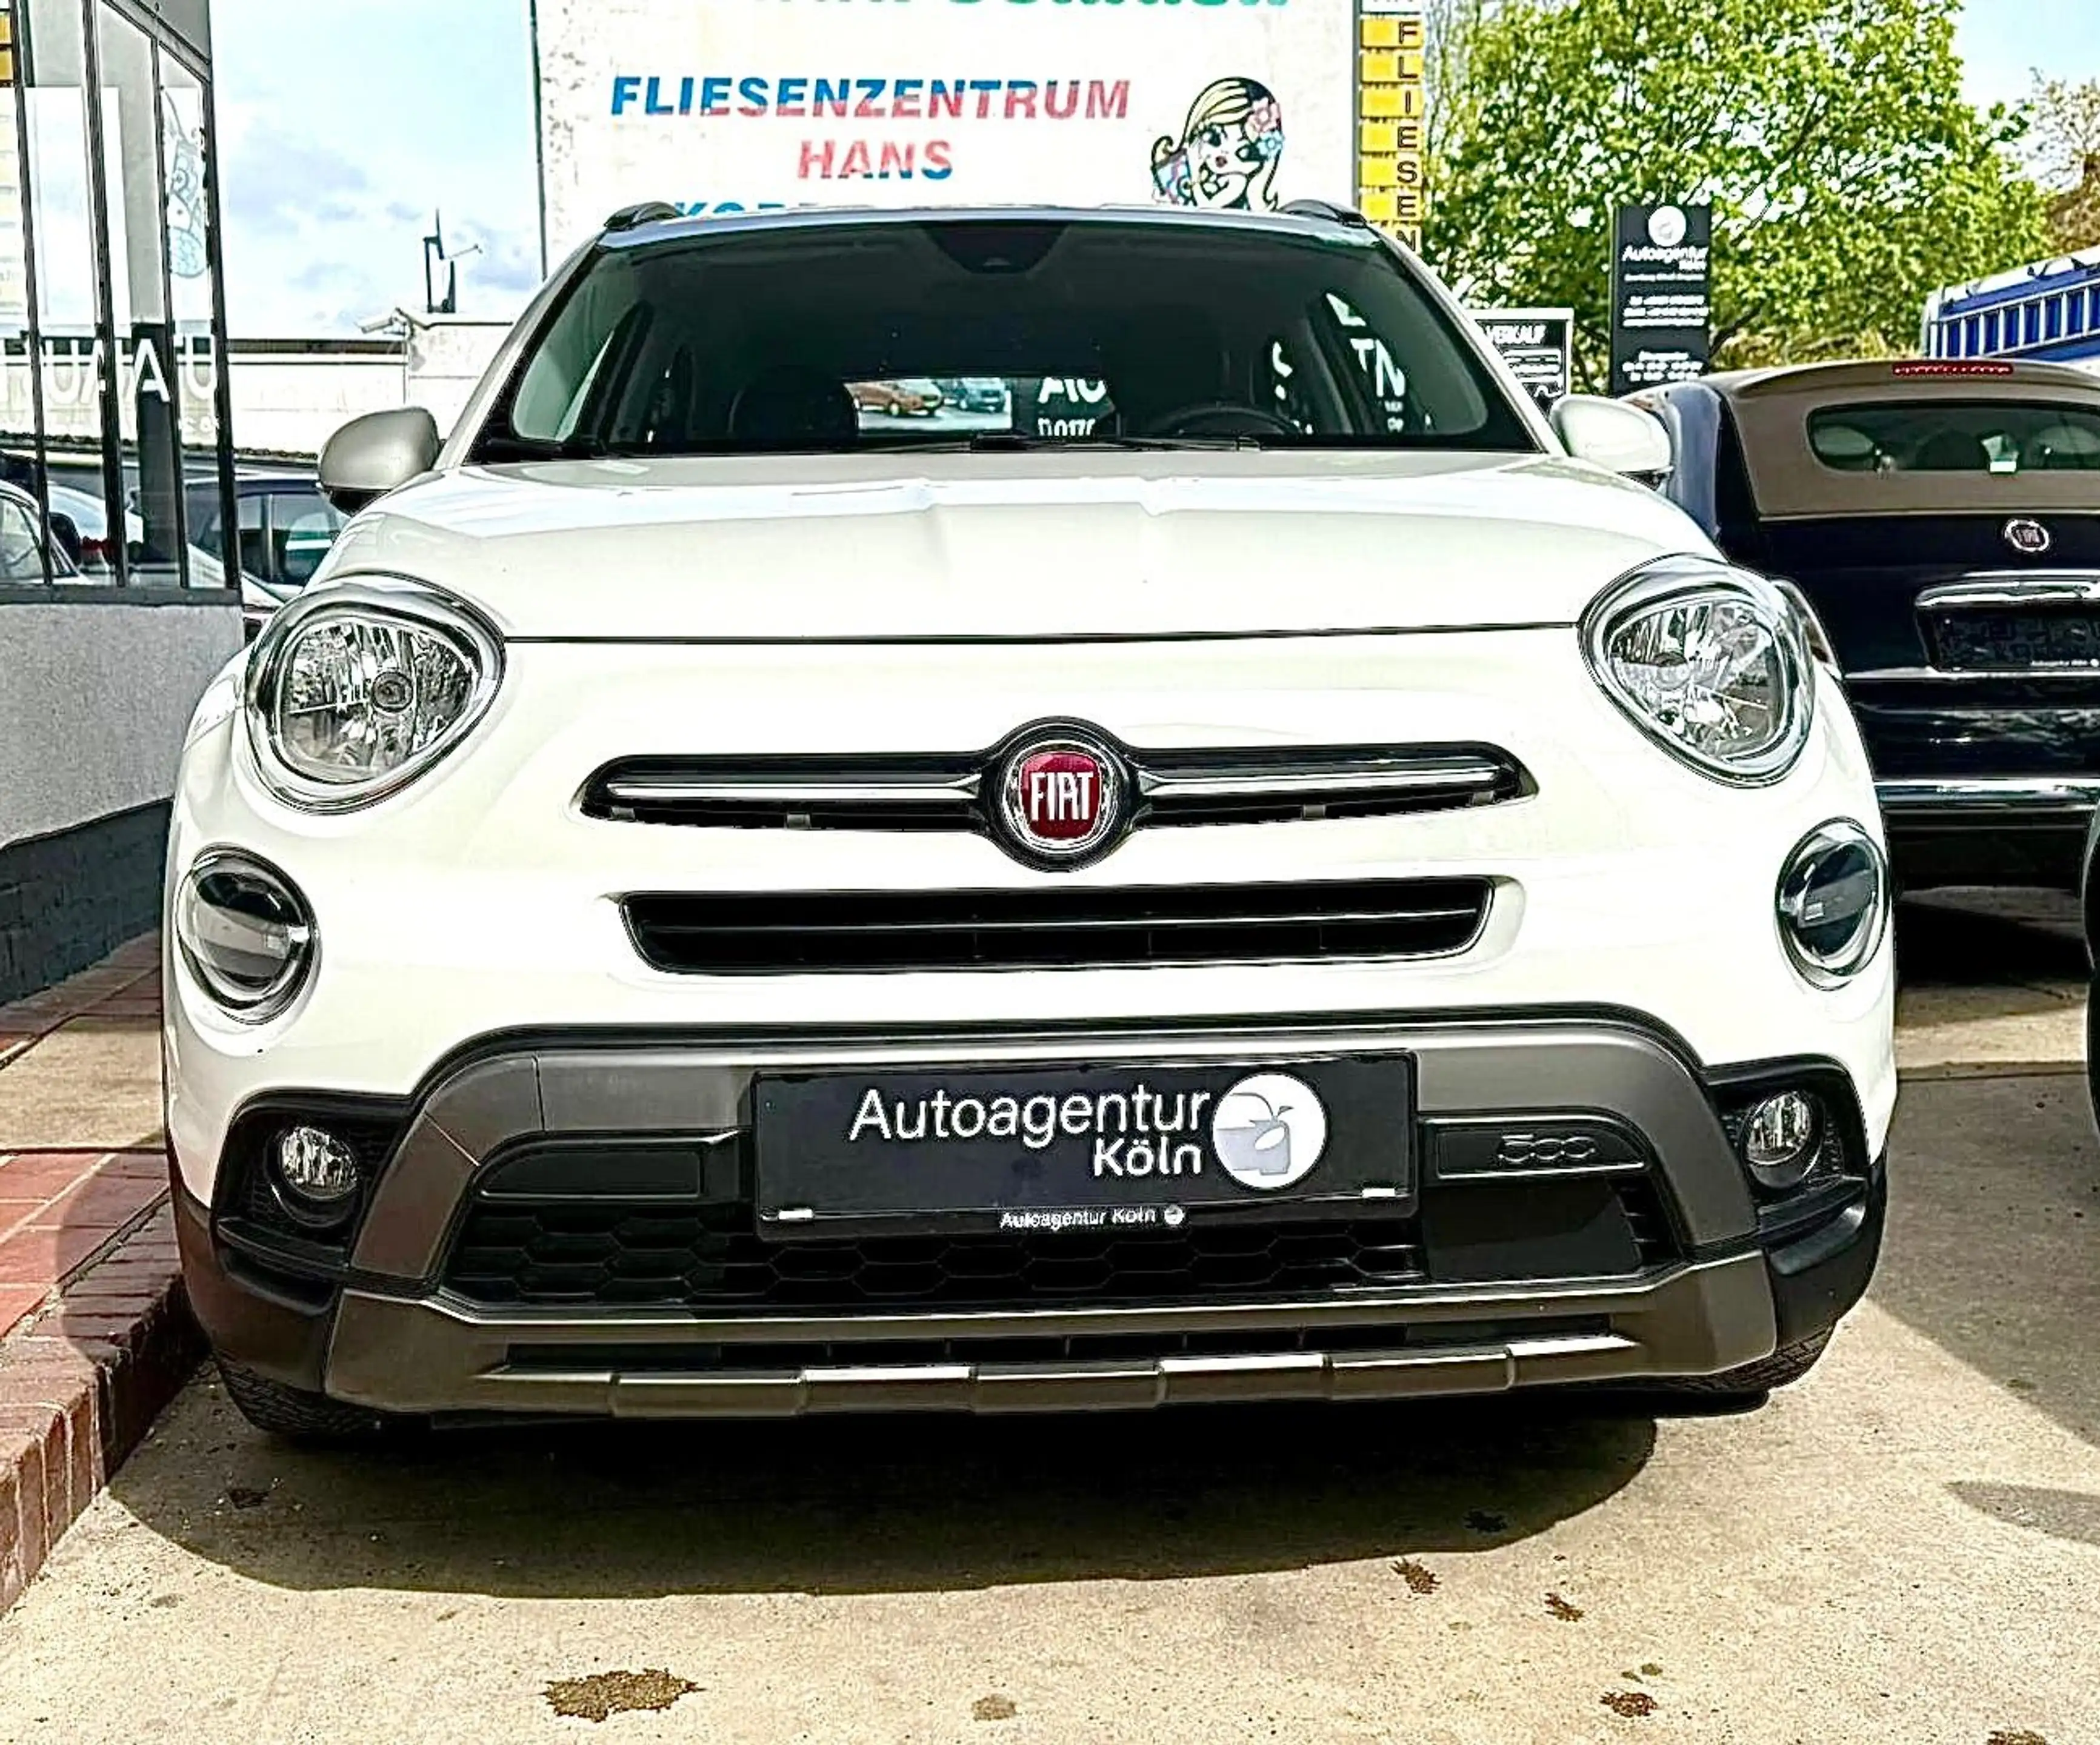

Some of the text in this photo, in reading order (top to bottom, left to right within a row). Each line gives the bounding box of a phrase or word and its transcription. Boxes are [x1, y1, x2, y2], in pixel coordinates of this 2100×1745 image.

[611, 76, 1130, 120] FLIESENZENTRUM
[798, 139, 953, 180] HANS
[1030, 771, 1094, 821] FIAT
[850, 1084, 1210, 1149] Autoagentur
[1094, 1136, 1201, 1177] Köln
[1000, 1212, 1106, 1231] Autoagentur
